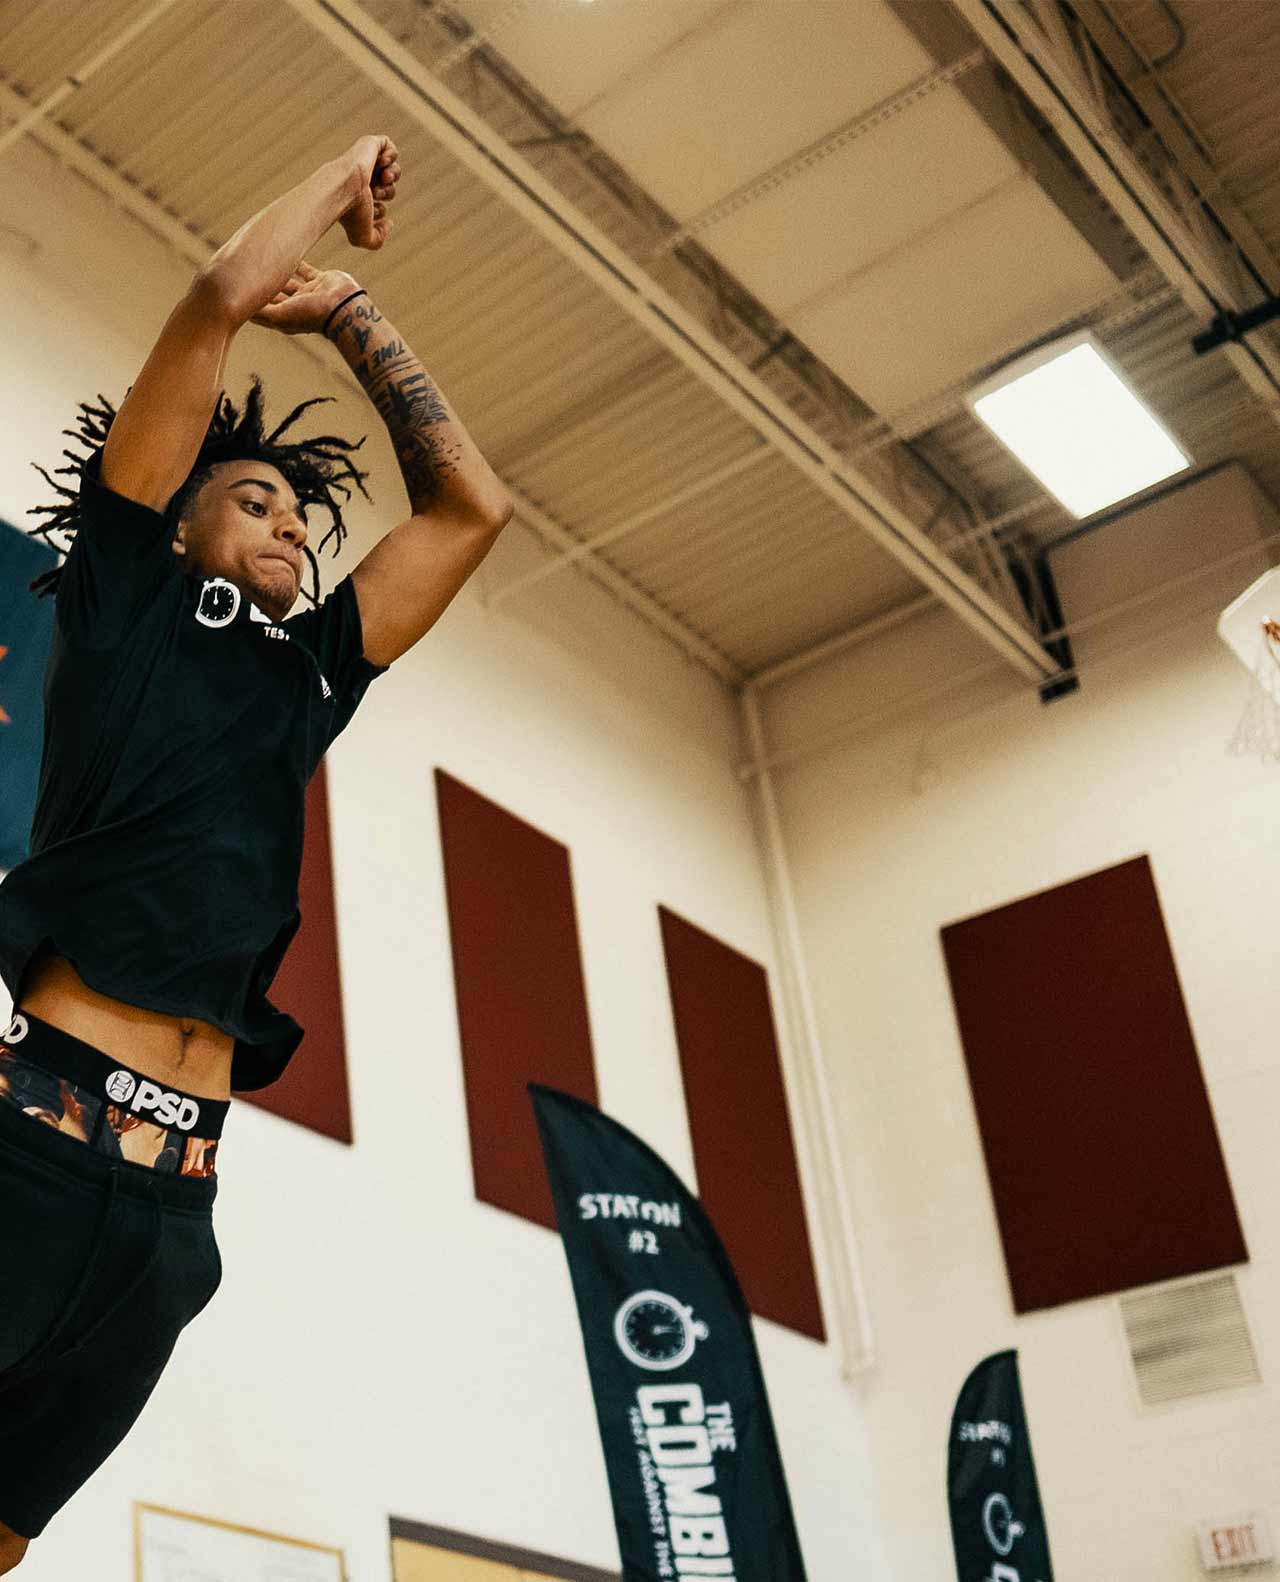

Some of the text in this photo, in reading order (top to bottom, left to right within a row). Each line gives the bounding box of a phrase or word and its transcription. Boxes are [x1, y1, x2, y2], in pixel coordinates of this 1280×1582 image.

[130, 1080, 200, 1131] PSD
[578, 1193, 681, 1228] STATON
[628, 1230, 660, 1255] #2
[705, 1401, 737, 1452] THE
[637, 1383, 737, 1582] COMBI
[638, 1449, 667, 1537] AGAINST
